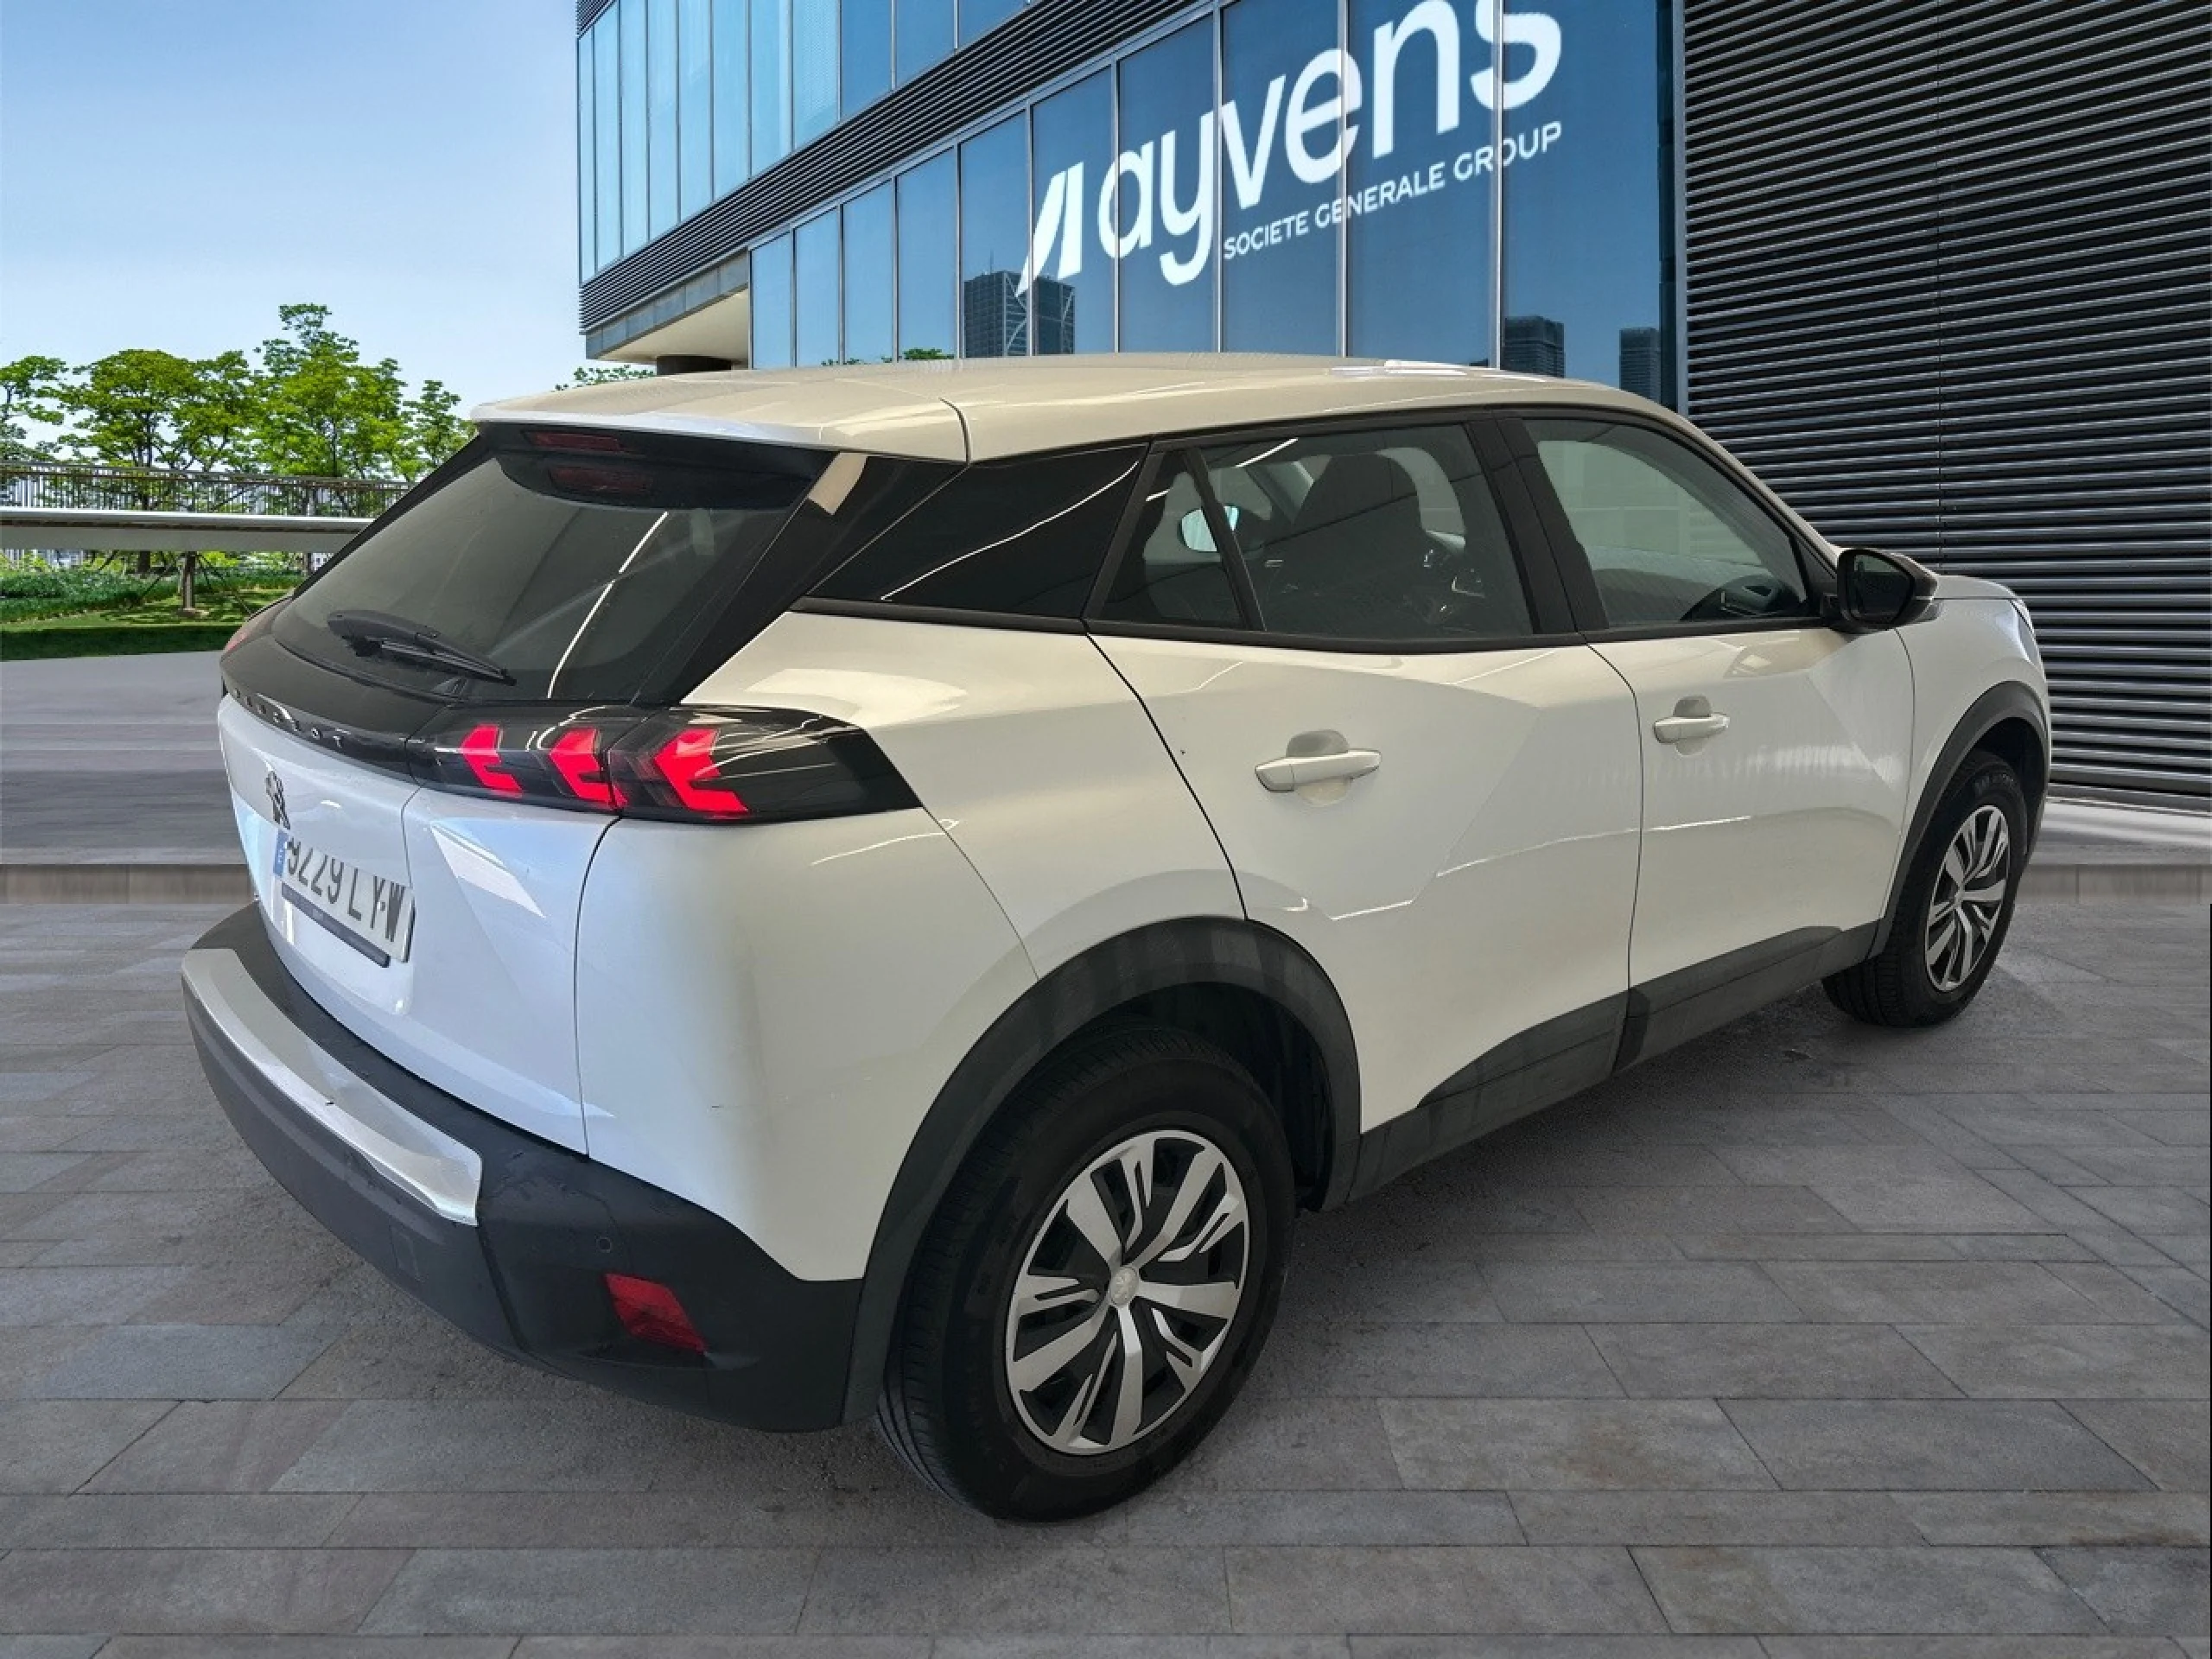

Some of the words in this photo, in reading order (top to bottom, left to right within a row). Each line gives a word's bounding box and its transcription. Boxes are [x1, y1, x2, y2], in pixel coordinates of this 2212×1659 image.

[1098, 0, 1562, 285] ayvens
[1224, 210, 1309, 259] SOCIETE
[1315, 162, 1446, 228] GENERALE
[1453, 121, 1561, 181] GROUP
